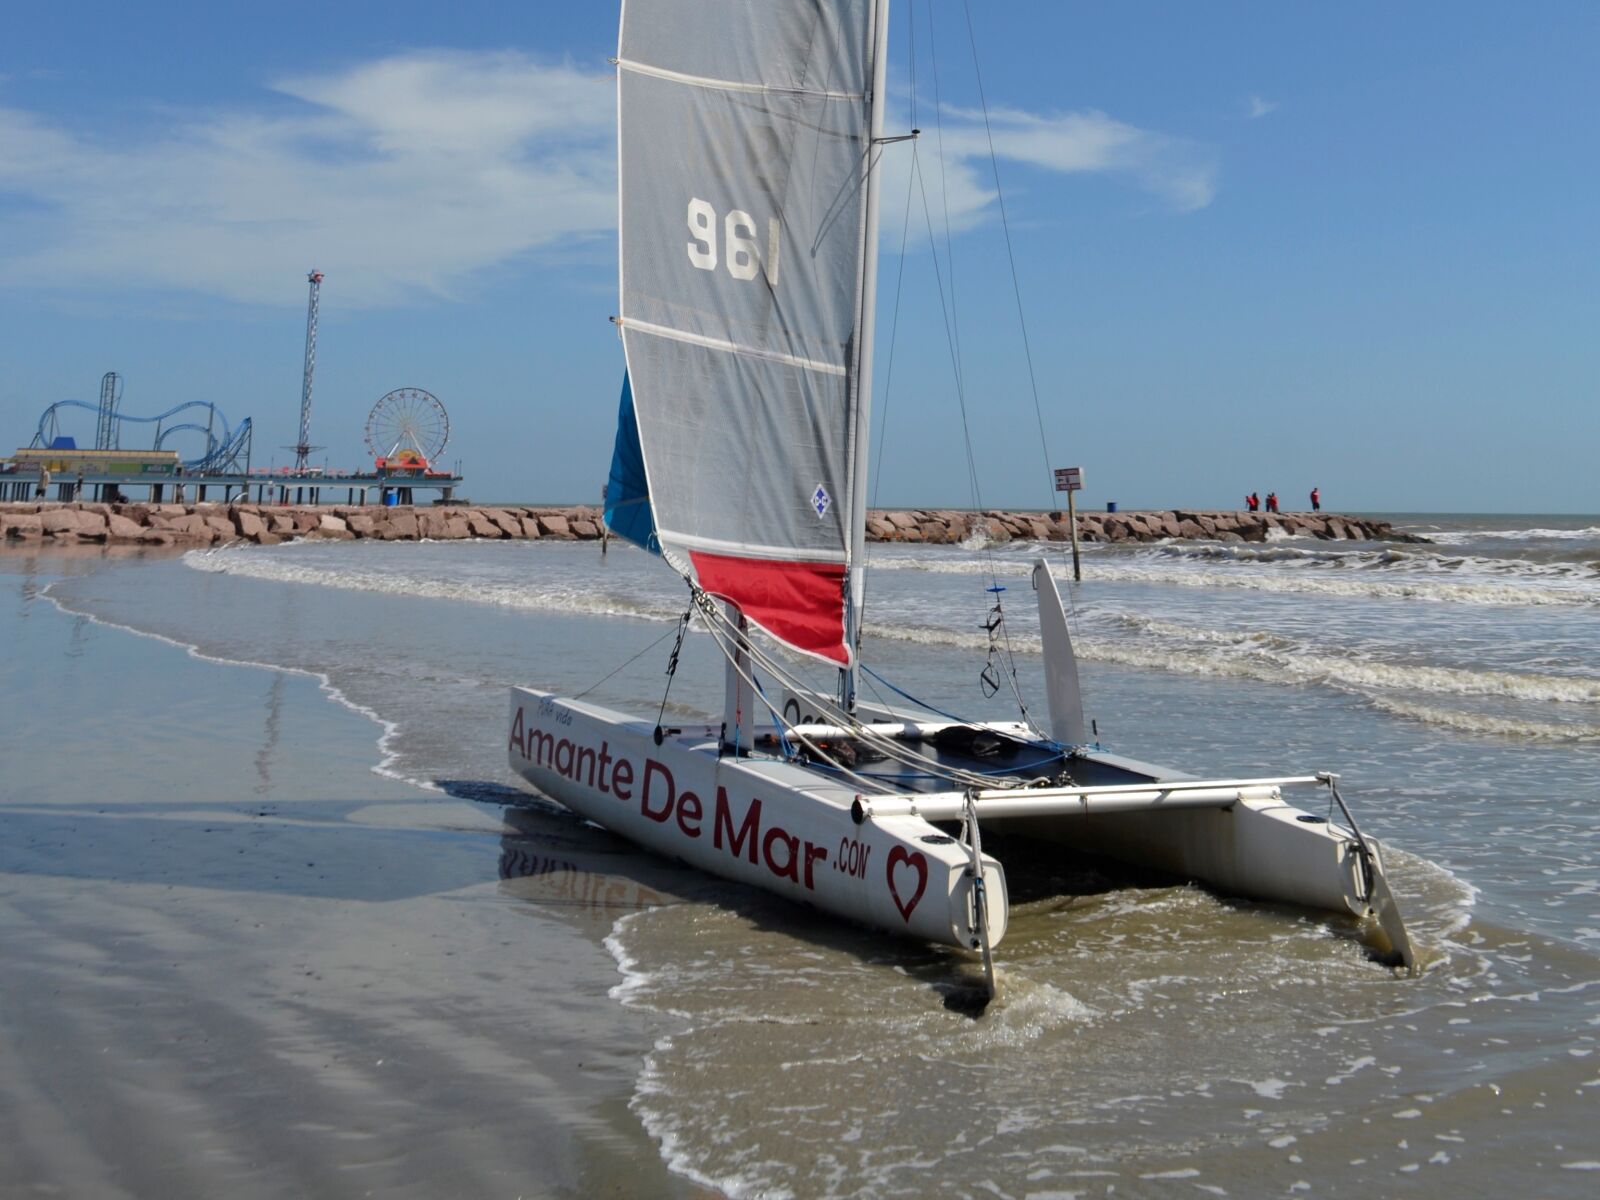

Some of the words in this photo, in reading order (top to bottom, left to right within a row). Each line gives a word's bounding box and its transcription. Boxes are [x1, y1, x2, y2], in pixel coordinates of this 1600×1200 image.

[687, 197, 780, 286] 961
[509, 707, 634, 801] Amante
[641, 758, 703, 838] De
